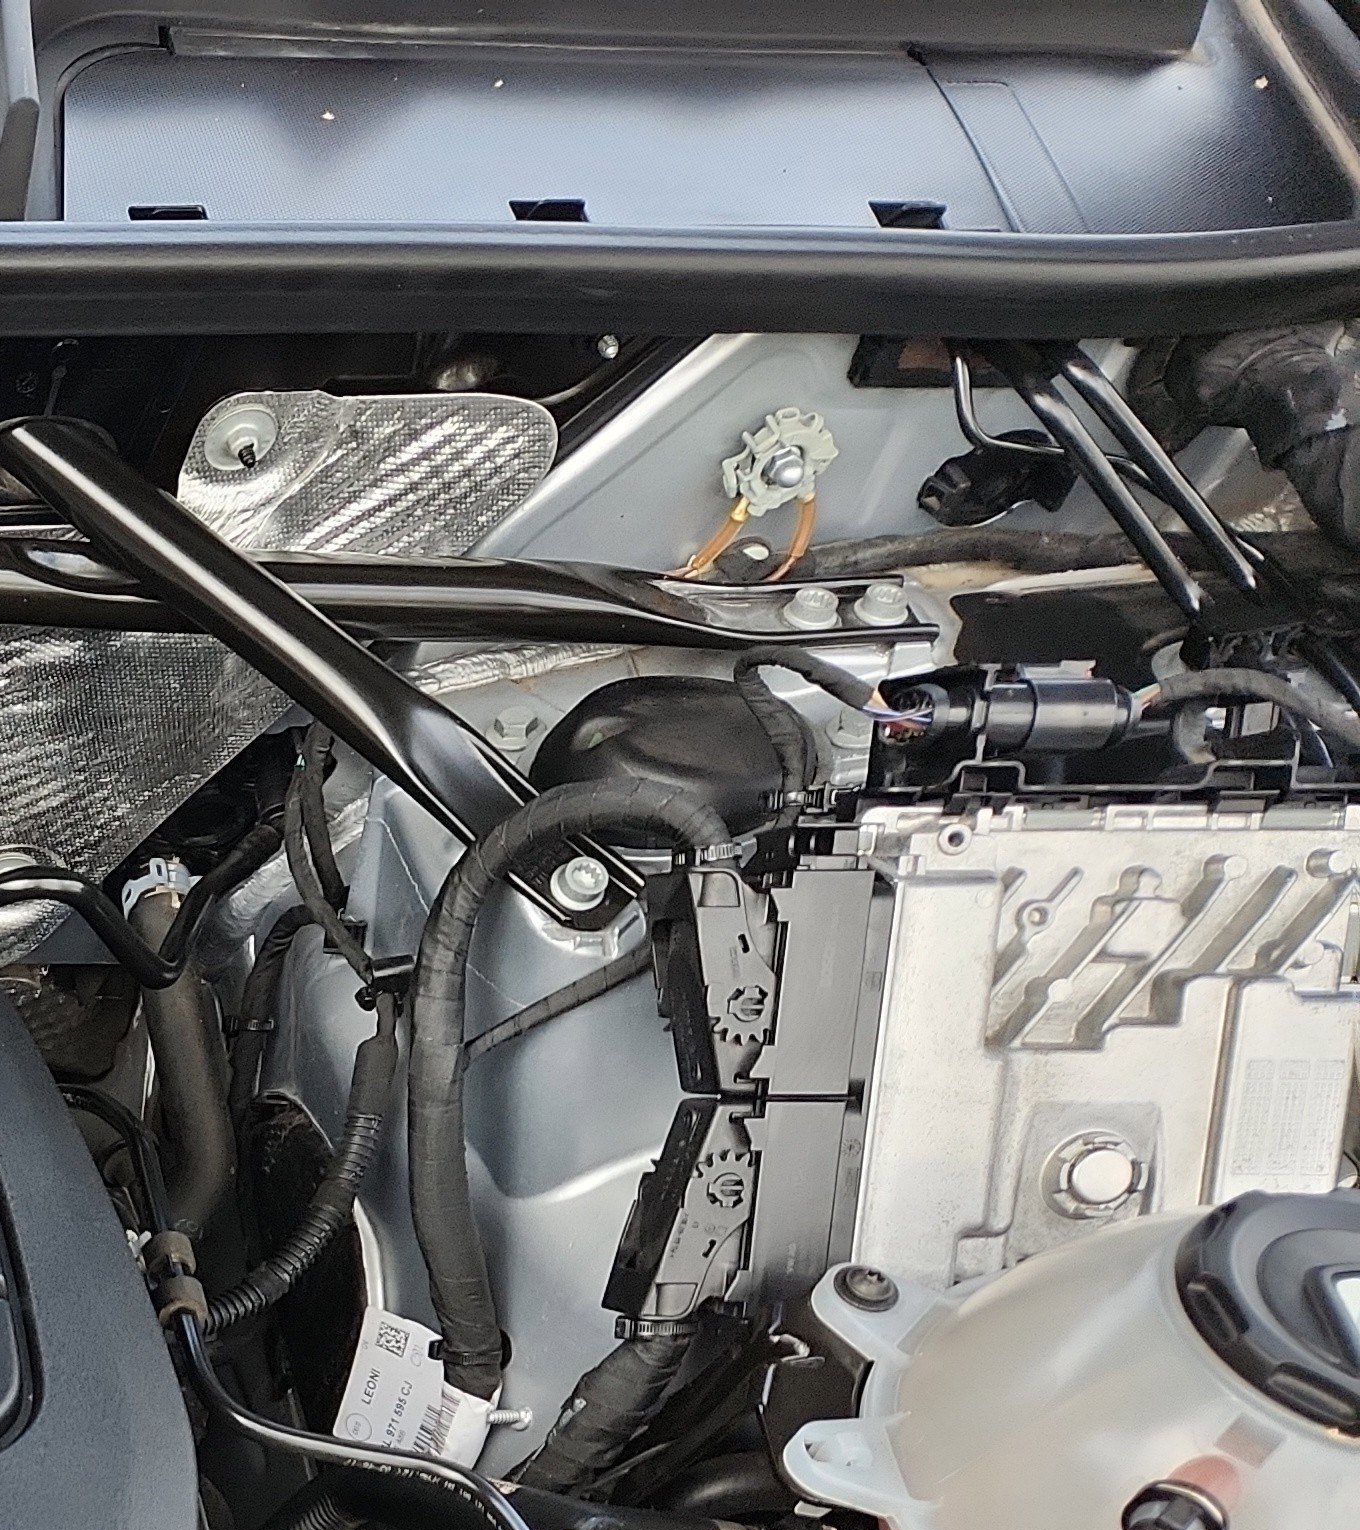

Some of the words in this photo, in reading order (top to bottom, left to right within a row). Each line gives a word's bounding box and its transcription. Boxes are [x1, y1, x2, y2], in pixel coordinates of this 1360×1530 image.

[361, 1368, 381, 1405] LEONI
[386, 1417, 399, 1437] 971
[401, 1381, 413, 1396] CJ
